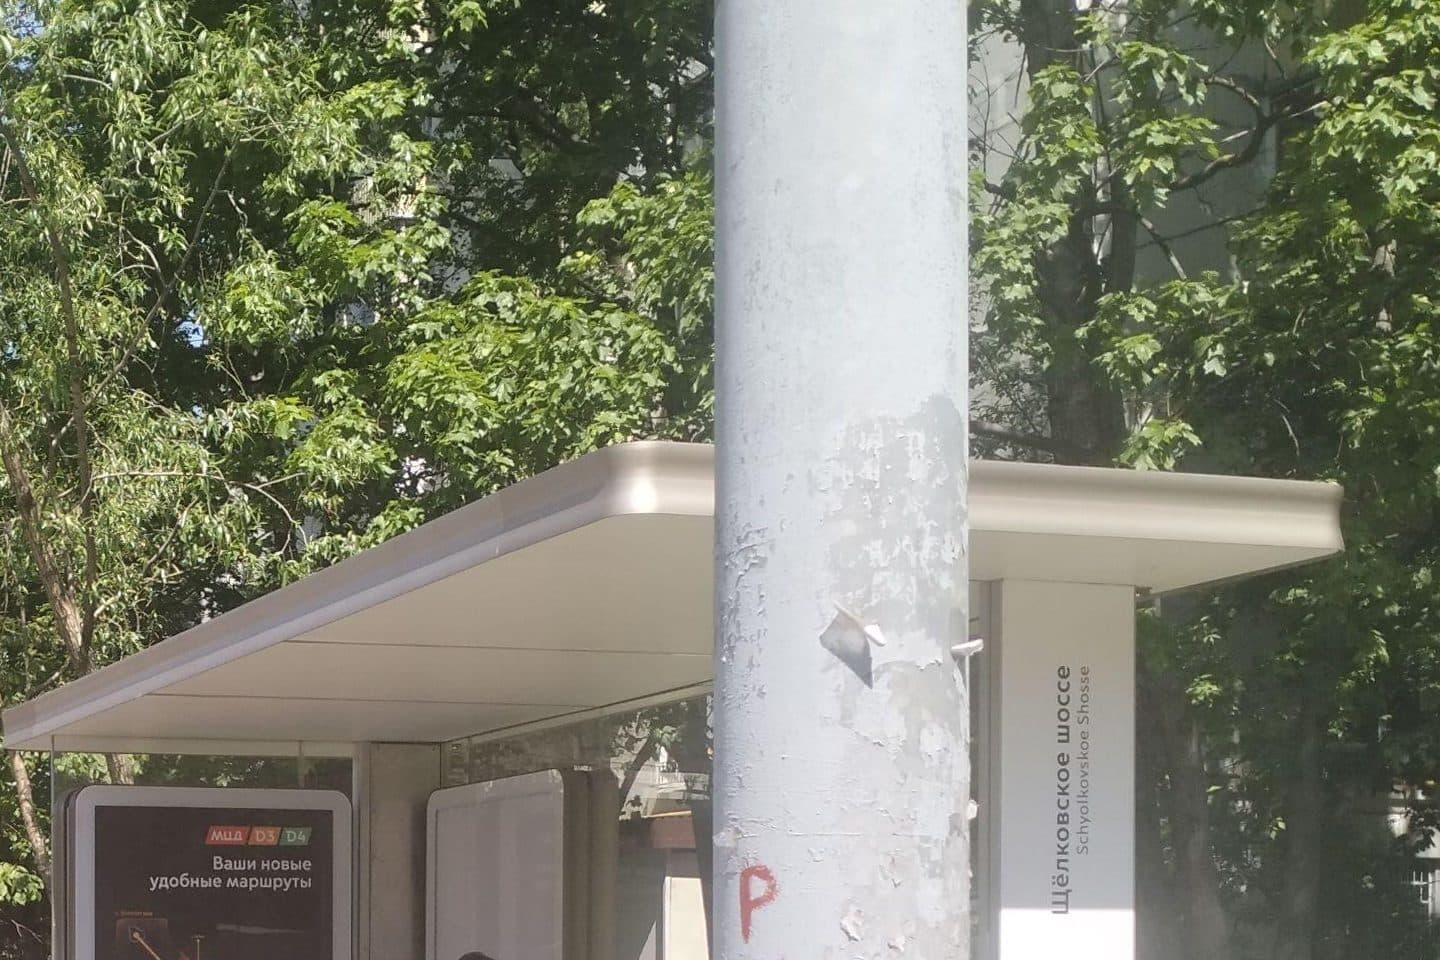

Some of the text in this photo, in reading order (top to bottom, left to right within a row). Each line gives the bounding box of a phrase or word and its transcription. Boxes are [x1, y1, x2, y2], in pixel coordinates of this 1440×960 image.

[1076, 665, 1091, 855] Schyolkovskoe Shosse
[1051, 665, 1072, 915] Щёлковское шоссе
[255, 830, 275, 842] D3
[286, 830, 306, 842] D4
[213, 856, 312, 871] Ваши новые
[149, 873, 312, 892] удобные маршруты
